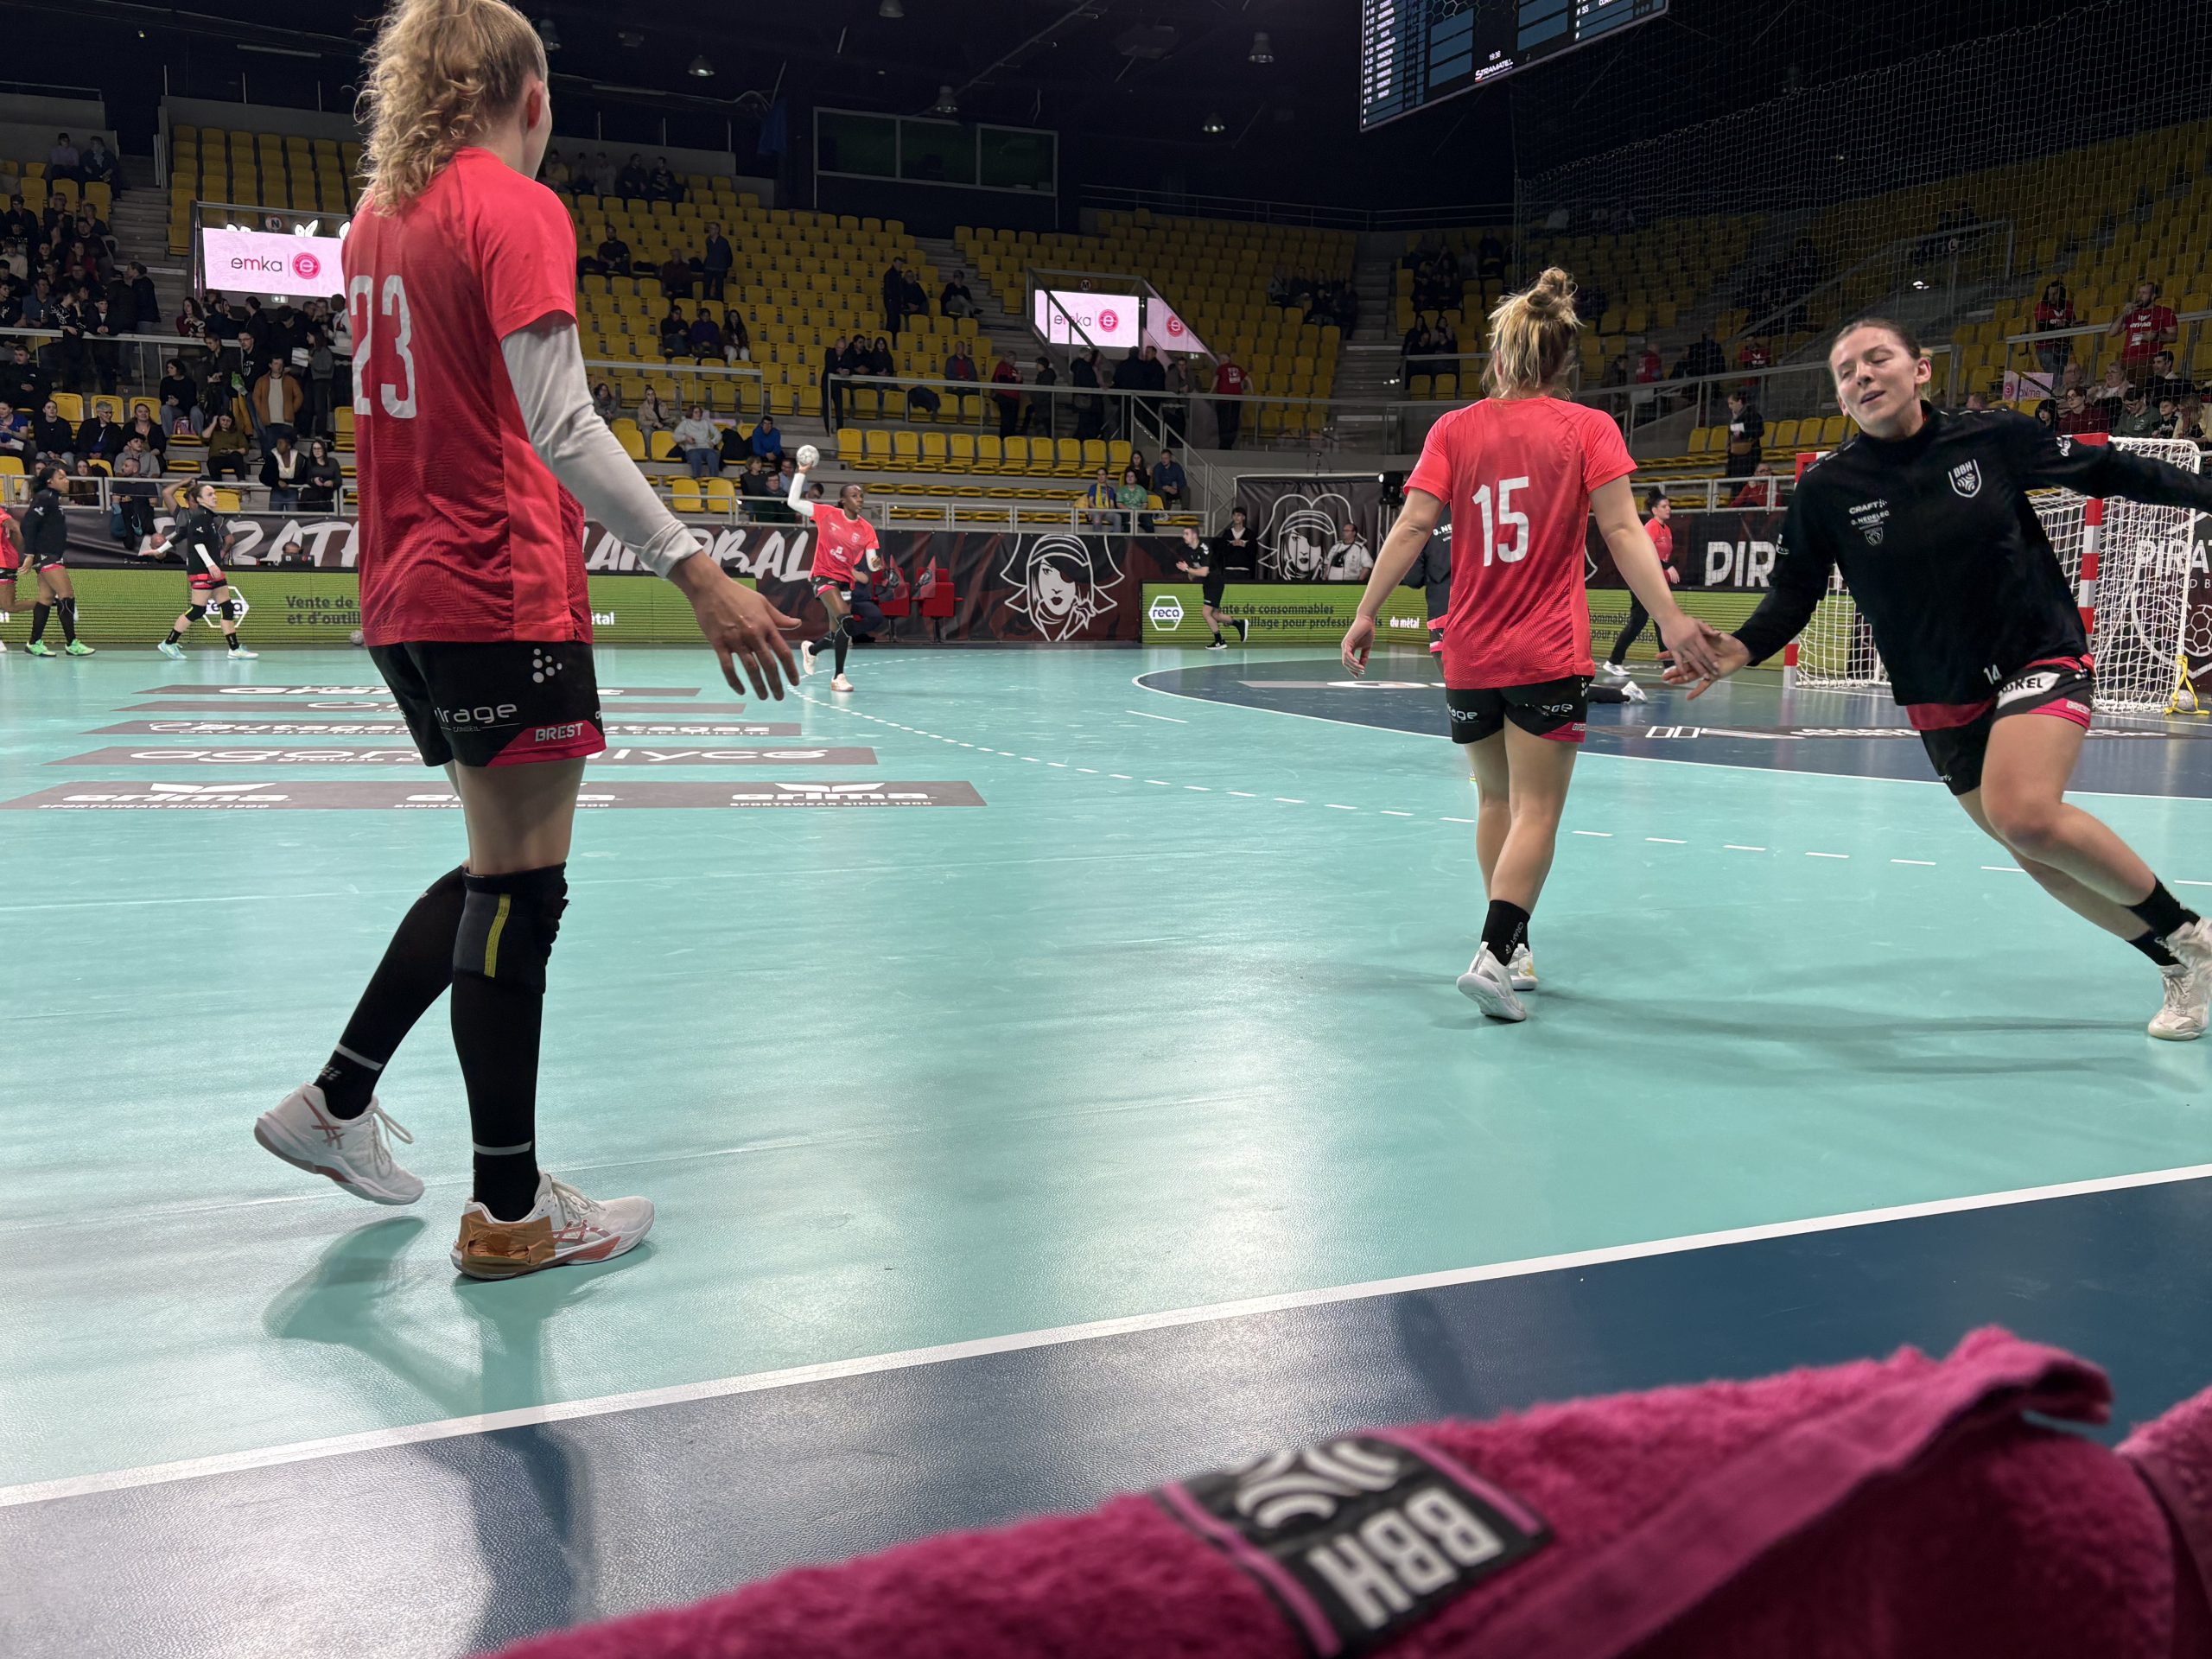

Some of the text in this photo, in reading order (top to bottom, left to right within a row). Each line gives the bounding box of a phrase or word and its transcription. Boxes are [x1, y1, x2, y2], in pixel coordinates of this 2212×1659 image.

[231, 256, 283, 272] emka
[349, 275, 417, 419] 23
[1849, 501, 1878, 515] CRAFT
[1472, 476, 1529, 568] 15
[286, 596, 353, 609] Vente de
[1243, 603, 1255, 614] de
[1259, 604, 1334, 615] consommables
[287, 613, 301, 625] et
[1153, 608, 1179, 618] reca
[1282, 619, 1306, 629] pour
[535, 722, 584, 742] BREST
[62, 791, 929, 802] erima erima
[1306, 1487, 1505, 1630] BBH
